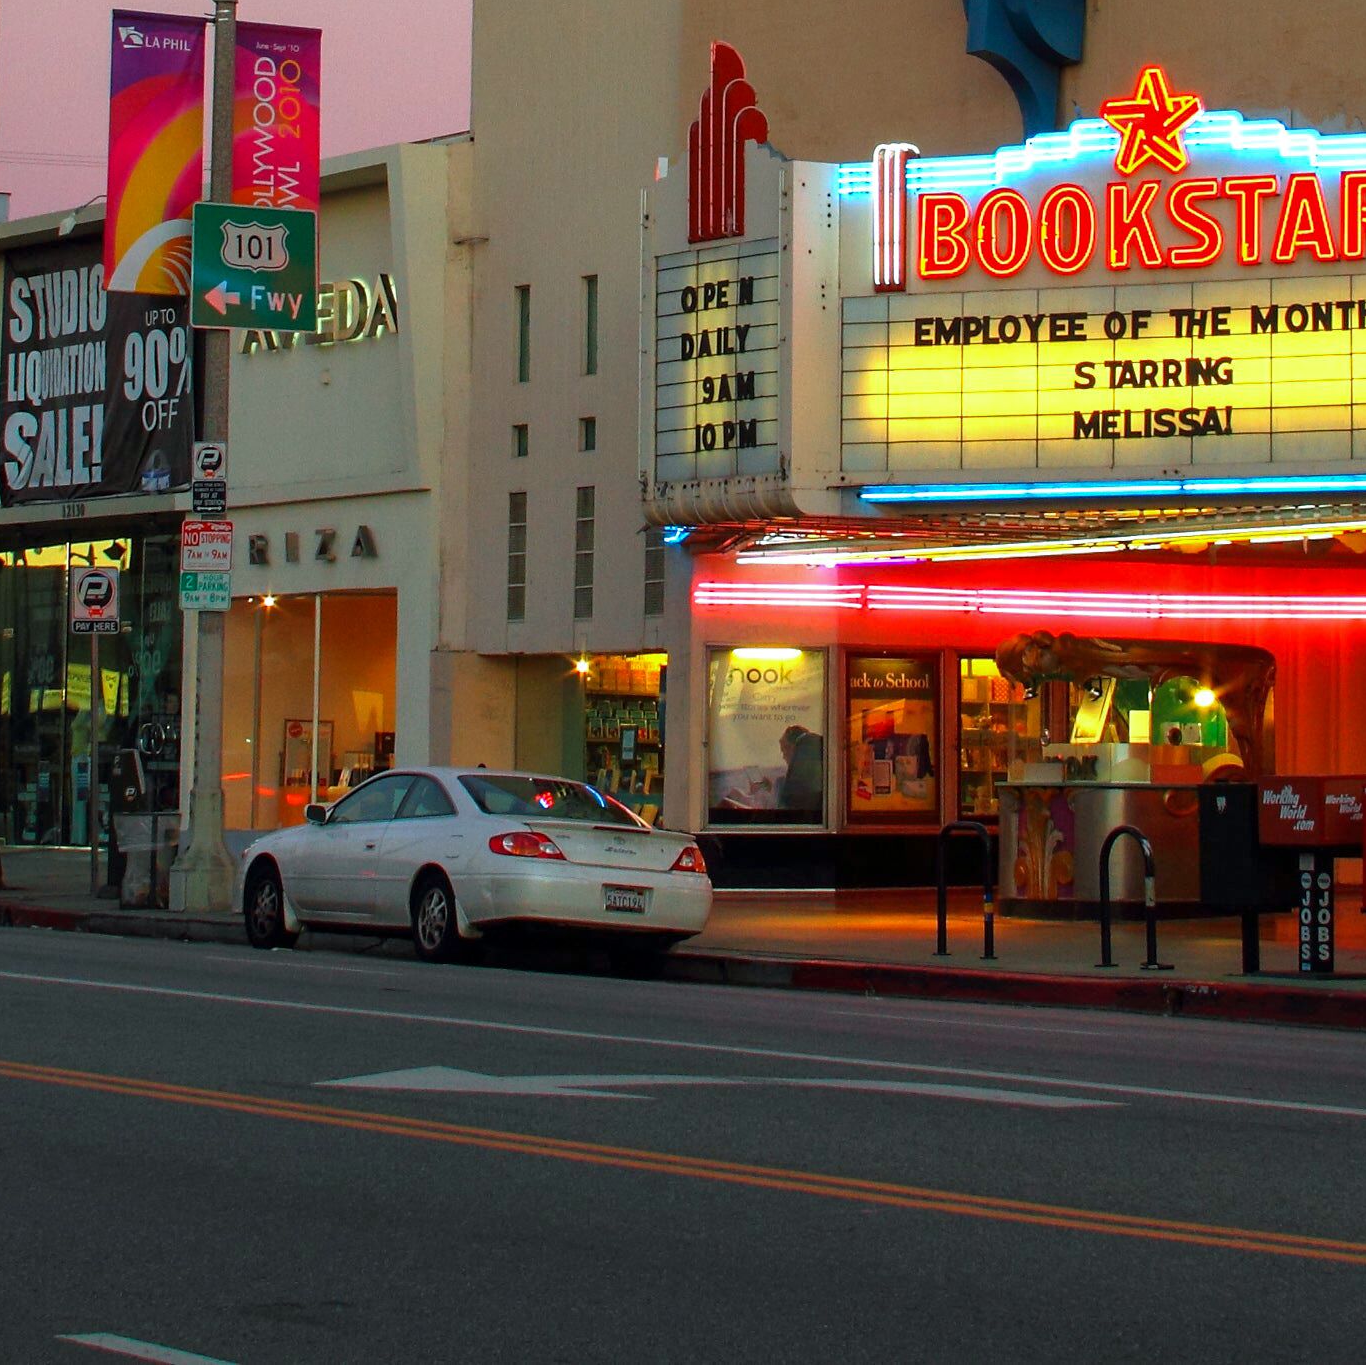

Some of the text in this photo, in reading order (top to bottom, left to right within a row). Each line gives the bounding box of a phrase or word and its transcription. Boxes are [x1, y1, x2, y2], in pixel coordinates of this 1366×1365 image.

[145, 36, 192, 52] LA PHIL
[277, 59, 301, 139] 2010
[252, 56, 277, 209] LLYWOOD
[236, 233, 273, 261] 101
[9, 262, 108, 343] STUDIO
[250, 285, 303, 321] Fwy
[680, 276, 755, 314] OPEN
[145, 307, 176, 327] UP TO
[913, 311, 1089, 347] EMPLOYEE
[1103, 309, 1153, 340] OF
[1169, 306, 1232, 339] THE
[680, 323, 751, 362] DAILY
[7, 340, 107, 407] LIQUIDATION
[1073, 356, 1234, 391] STARRING
[142, 398, 180, 432] OFF
[4, 403, 105, 491] SALE!
[184, 532, 231, 546] NO STOPPING
[248, 524, 380, 566] RIZA
[185, 575, 194, 589] 2
[198, 582, 229, 593] PARKING
[74, 620, 117, 632] PAY HERE
[729, 663, 794, 684] nook
[849, 671, 930, 689] ack to School
[1262, 789, 1300, 808] Working
[1279, 804, 1308, 820] World
[1300, 889, 1313, 962] JOBS
[1317, 889, 1332, 962] JOBS
